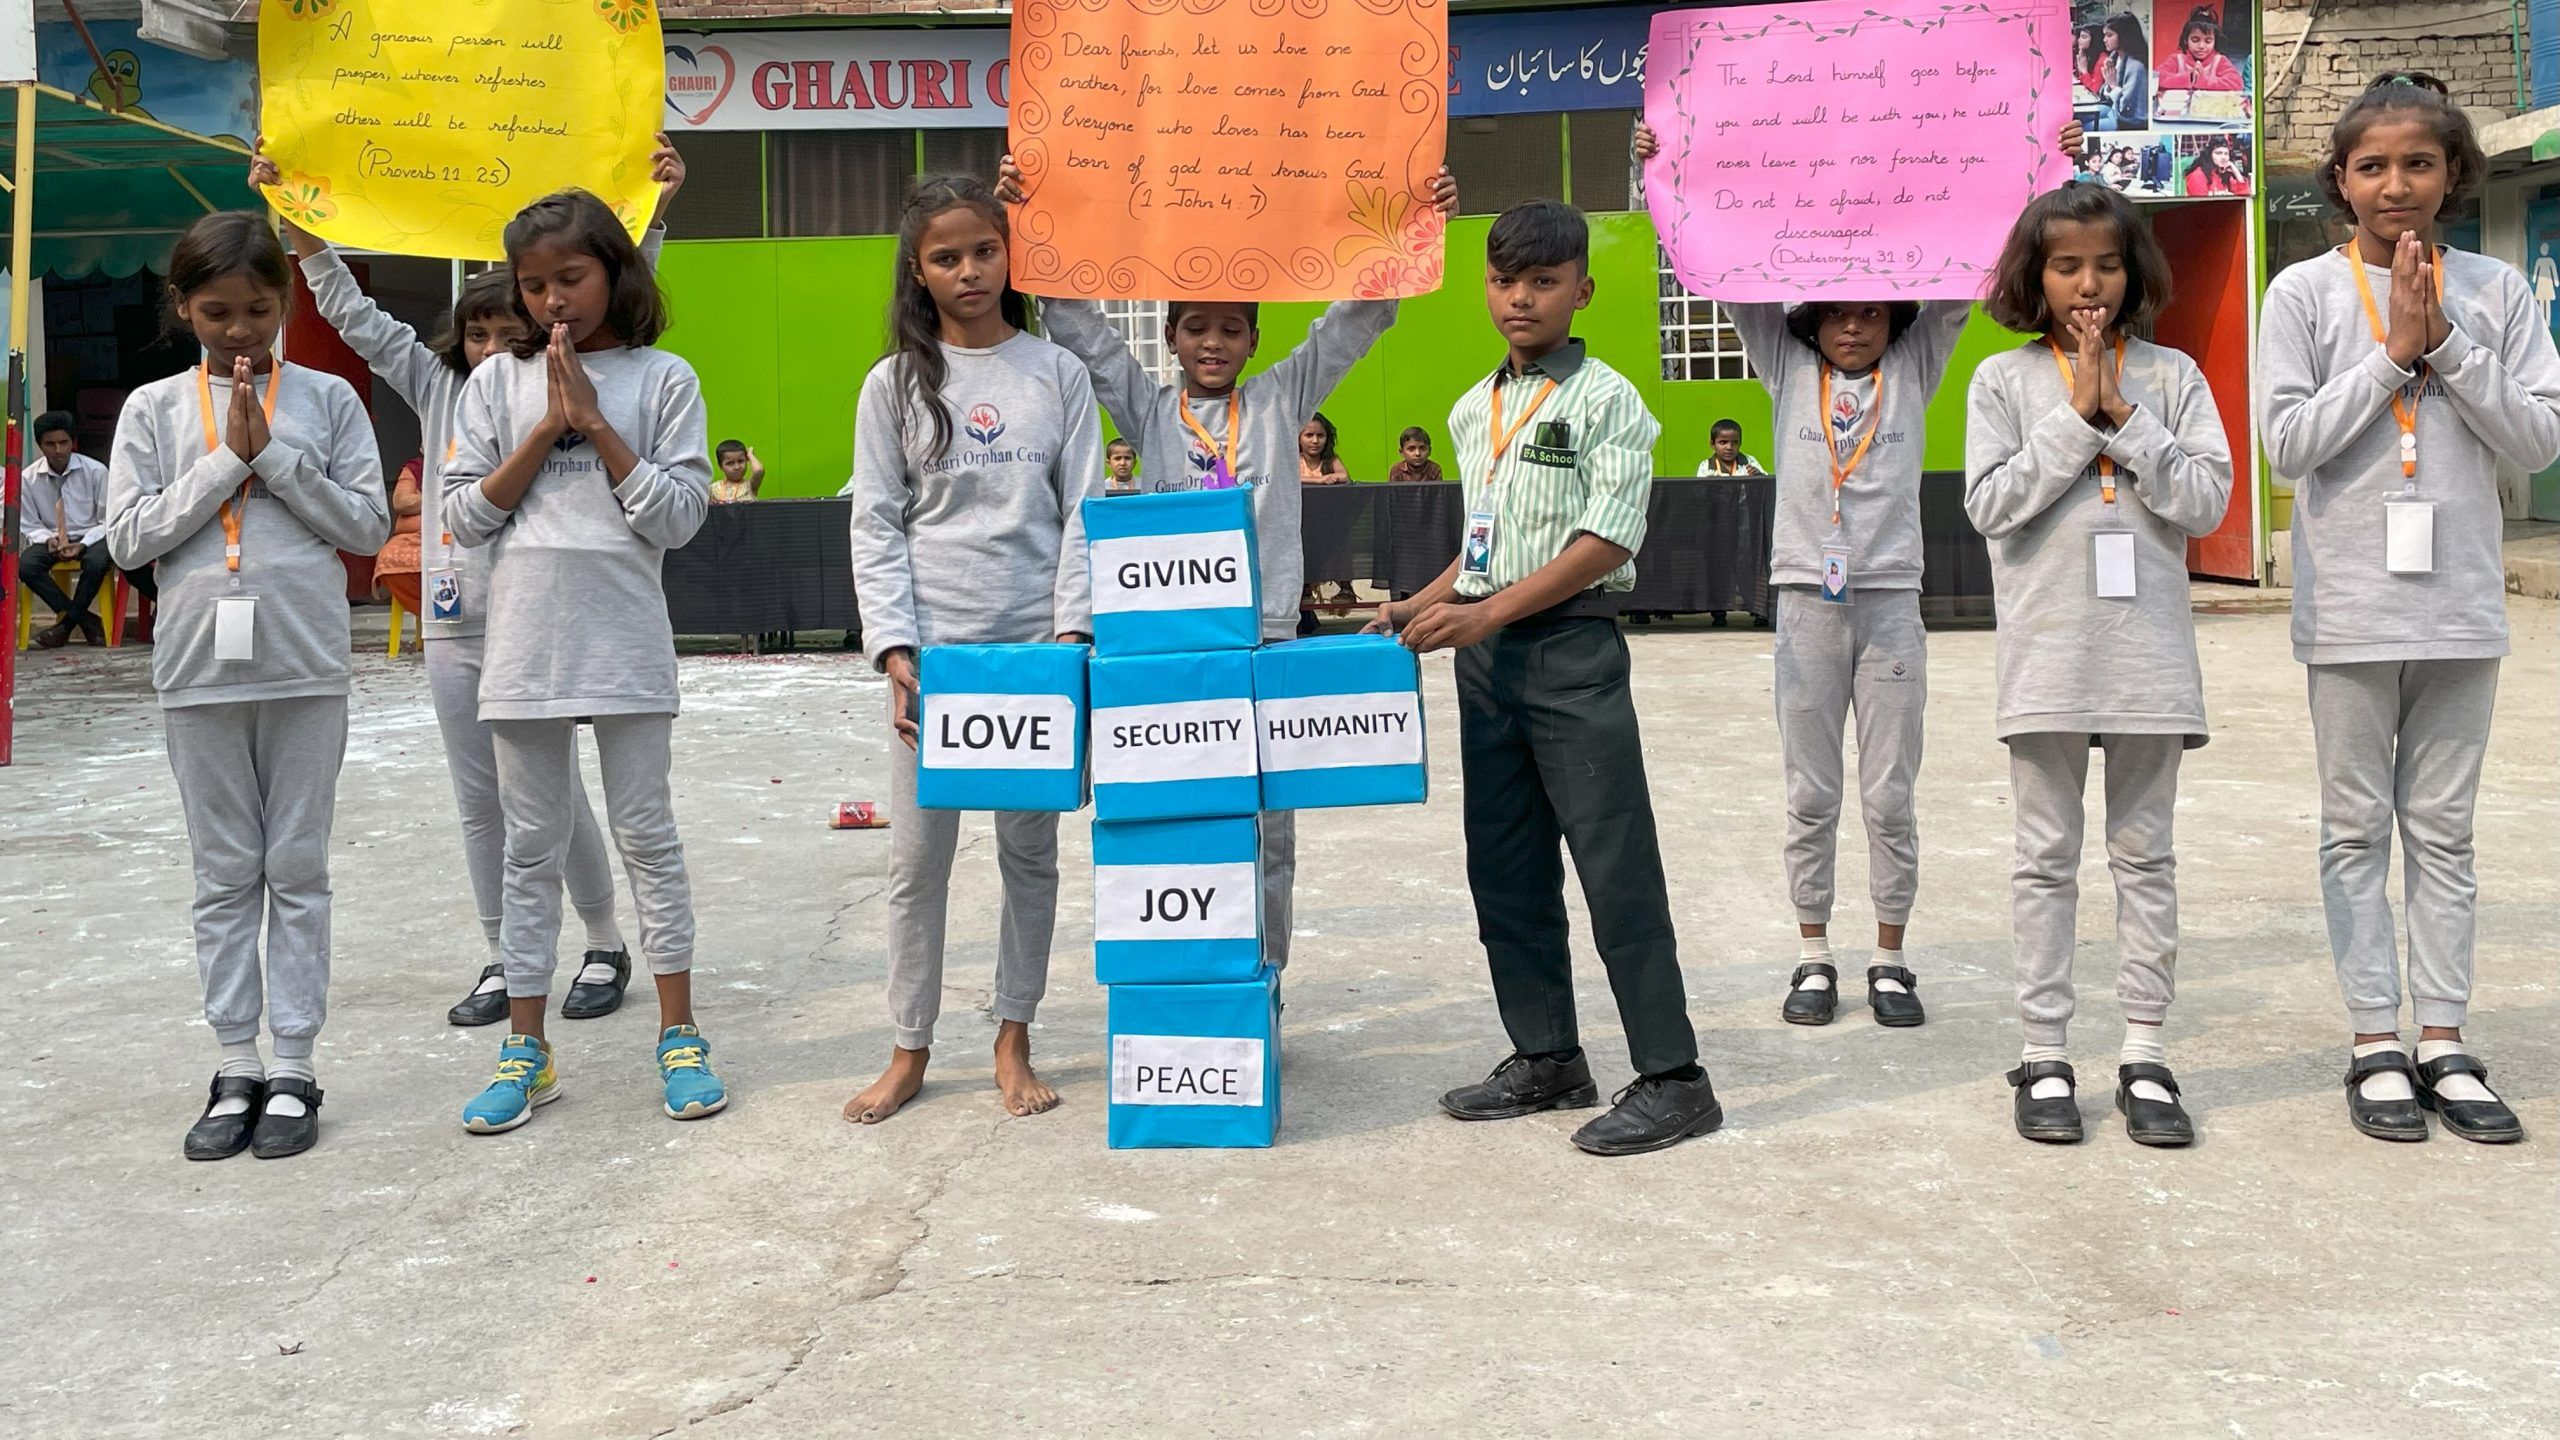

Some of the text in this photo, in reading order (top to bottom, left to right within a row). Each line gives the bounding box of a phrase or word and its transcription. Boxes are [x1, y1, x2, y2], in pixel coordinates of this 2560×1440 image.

[328, 10, 563, 58] A generous person will
[1061, 31, 1112, 56] Dear
[1192, 33, 1220, 55] let
[1238, 43, 1258, 55] us
[1272, 31, 1309, 55] love
[1325, 44, 1352, 56] one
[1580, 38, 1603, 79] کا
[1717, 58, 1997, 89] The Lord himself goes before
[401, 68, 460, 84] whoever
[474, 65, 546, 93] refreshes
[669, 76, 717, 91] GHAURI
[752, 60, 972, 110] GHAURI
[1136, 73, 1163, 107] for
[1177, 72, 1218, 95] love
[1234, 84, 1286, 97] comes
[1297, 78, 1341, 109] from
[393, 111, 433, 128] will
[448, 114, 467, 130] be
[1061, 104, 1366, 141] Everyone who loves has been
[1715, 119, 1740, 136] you
[1752, 112, 1782, 127] and
[1792, 105, 1828, 125] will
[1841, 108, 1858, 123] be
[1869, 107, 1901, 122] with
[1953, 108, 1967, 118] he
[1978, 101, 2010, 117] will
[476, 157, 511, 188] 25)
[1067, 149, 1109, 170] born
[1127, 154, 1145, 185] of
[1166, 157, 1202, 187] god
[1218, 161, 1252, 176] and
[1271, 160, 1328, 179] knows
[1716, 160, 1751, 169] never
[1809, 158, 1836, 178] you
[1850, 155, 1877, 165] nor
[1888, 148, 1949, 173] forsake
[1164, 188, 1214, 208] John
[1714, 189, 1744, 210] Do
[1752, 191, 1776, 208] not
[1795, 192, 1815, 208] be
[1893, 186, 1914, 204] do
[1925, 185, 1951, 202] not
[964, 448, 1012, 468] Orphan
[1540, 451, 1577, 465] School
[1118, 556, 1237, 590] GIVING
[941, 714, 1051, 752] LOVE
[1113, 719, 1242, 749] SECURITY
[1269, 712, 1408, 741] HUMANITY
[1140, 887, 1216, 922] JOY
[1137, 1065, 1238, 1096] PEACE
